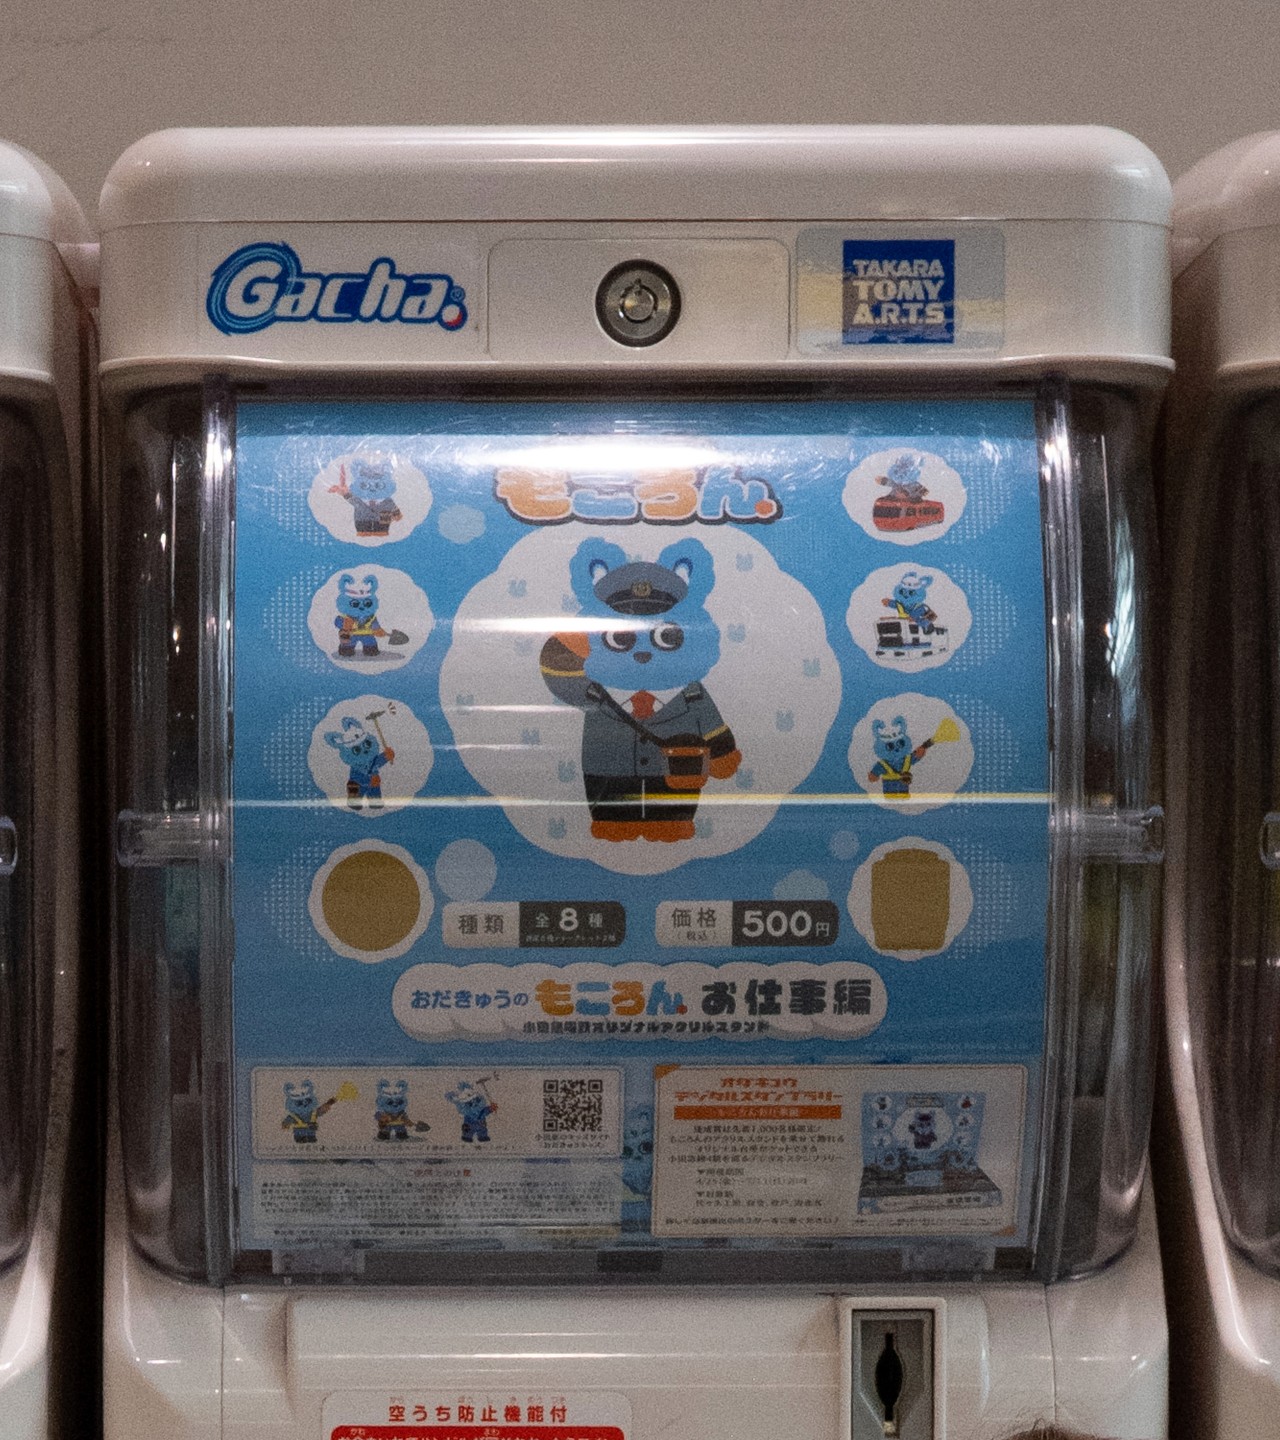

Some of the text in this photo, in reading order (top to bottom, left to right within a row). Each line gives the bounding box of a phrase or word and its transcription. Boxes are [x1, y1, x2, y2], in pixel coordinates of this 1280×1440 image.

[853, 260, 944, 278] TAKARA
[853, 280, 944, 301] TOMY
[458, 914, 505, 935] 種類
[672, 908, 717, 929] 価格
[742, 911, 830, 937] 500円
[411, 990, 529, 1010] おだきゅうの
[702, 979, 872, 1016] お仕事編
